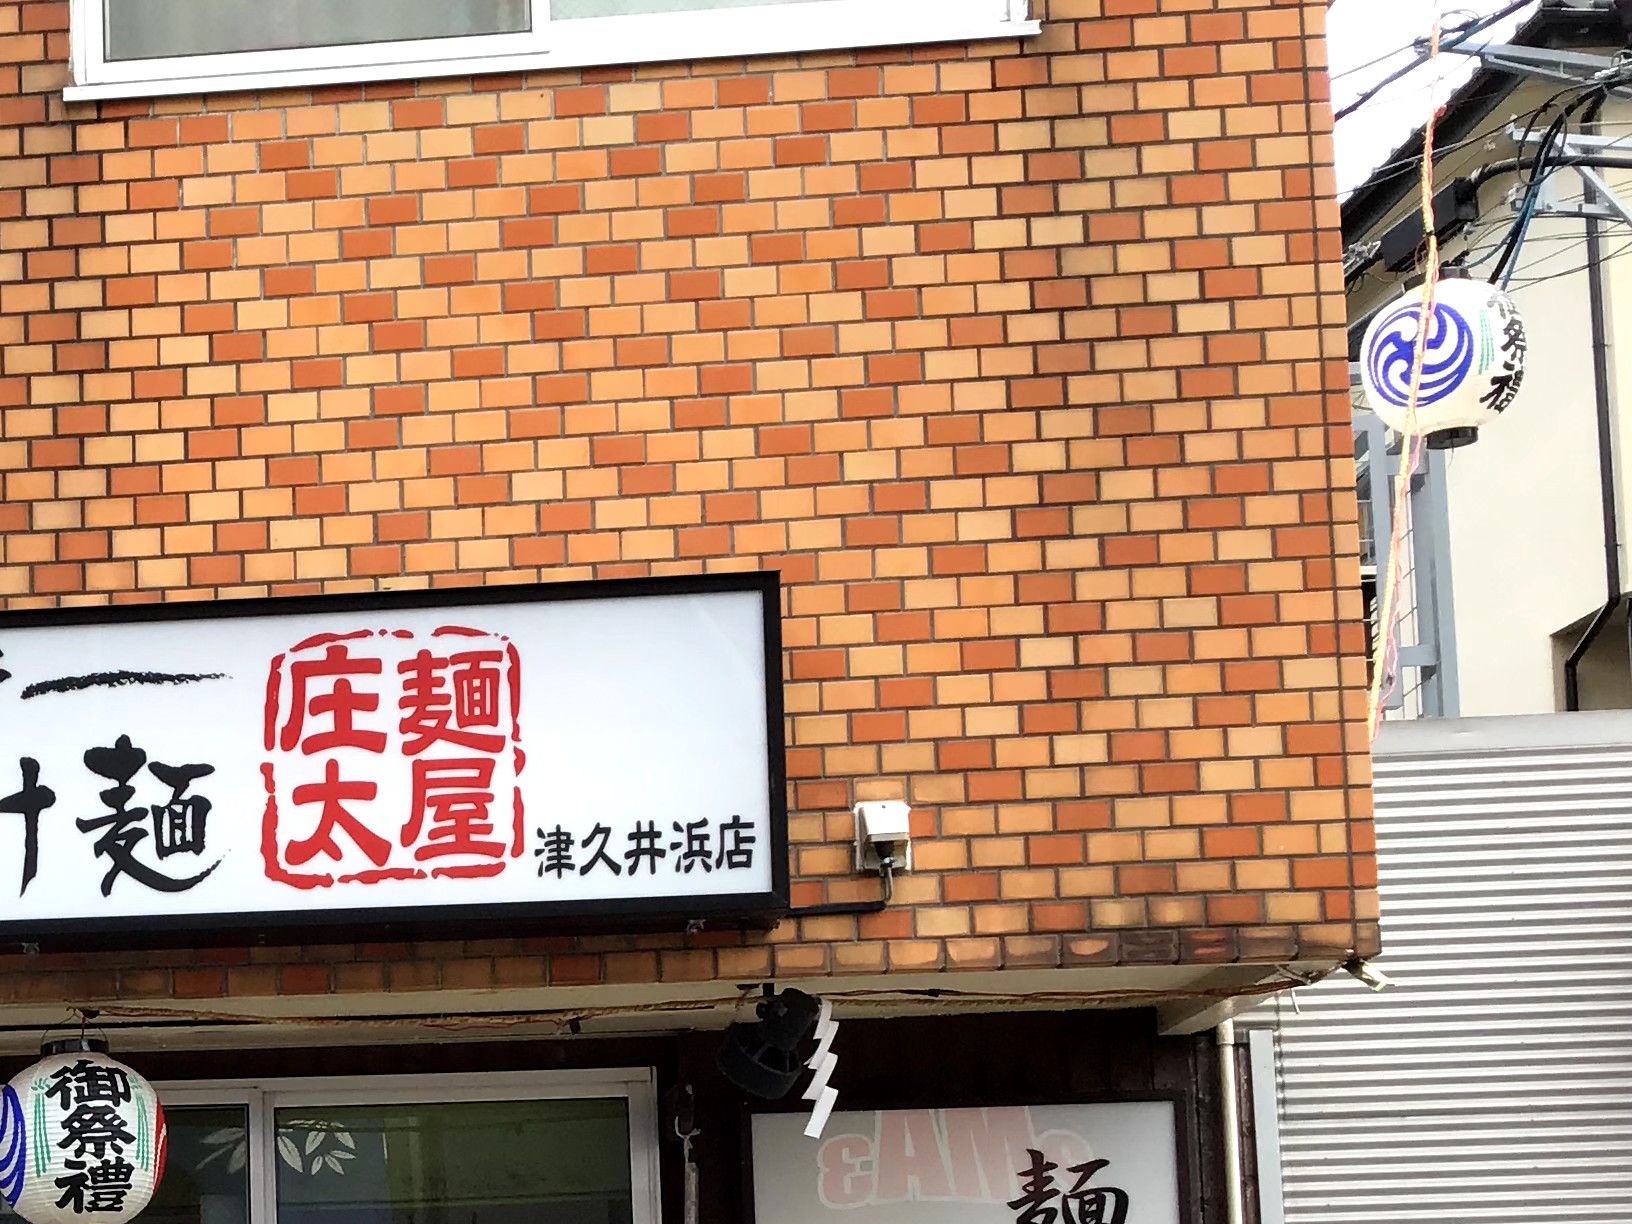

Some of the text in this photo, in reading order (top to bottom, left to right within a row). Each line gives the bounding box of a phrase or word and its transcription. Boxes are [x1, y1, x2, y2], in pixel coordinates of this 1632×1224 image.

[534, 814, 755, 880] 津久井浜店
[45, 1059, 137, 1213] 御祭禮
